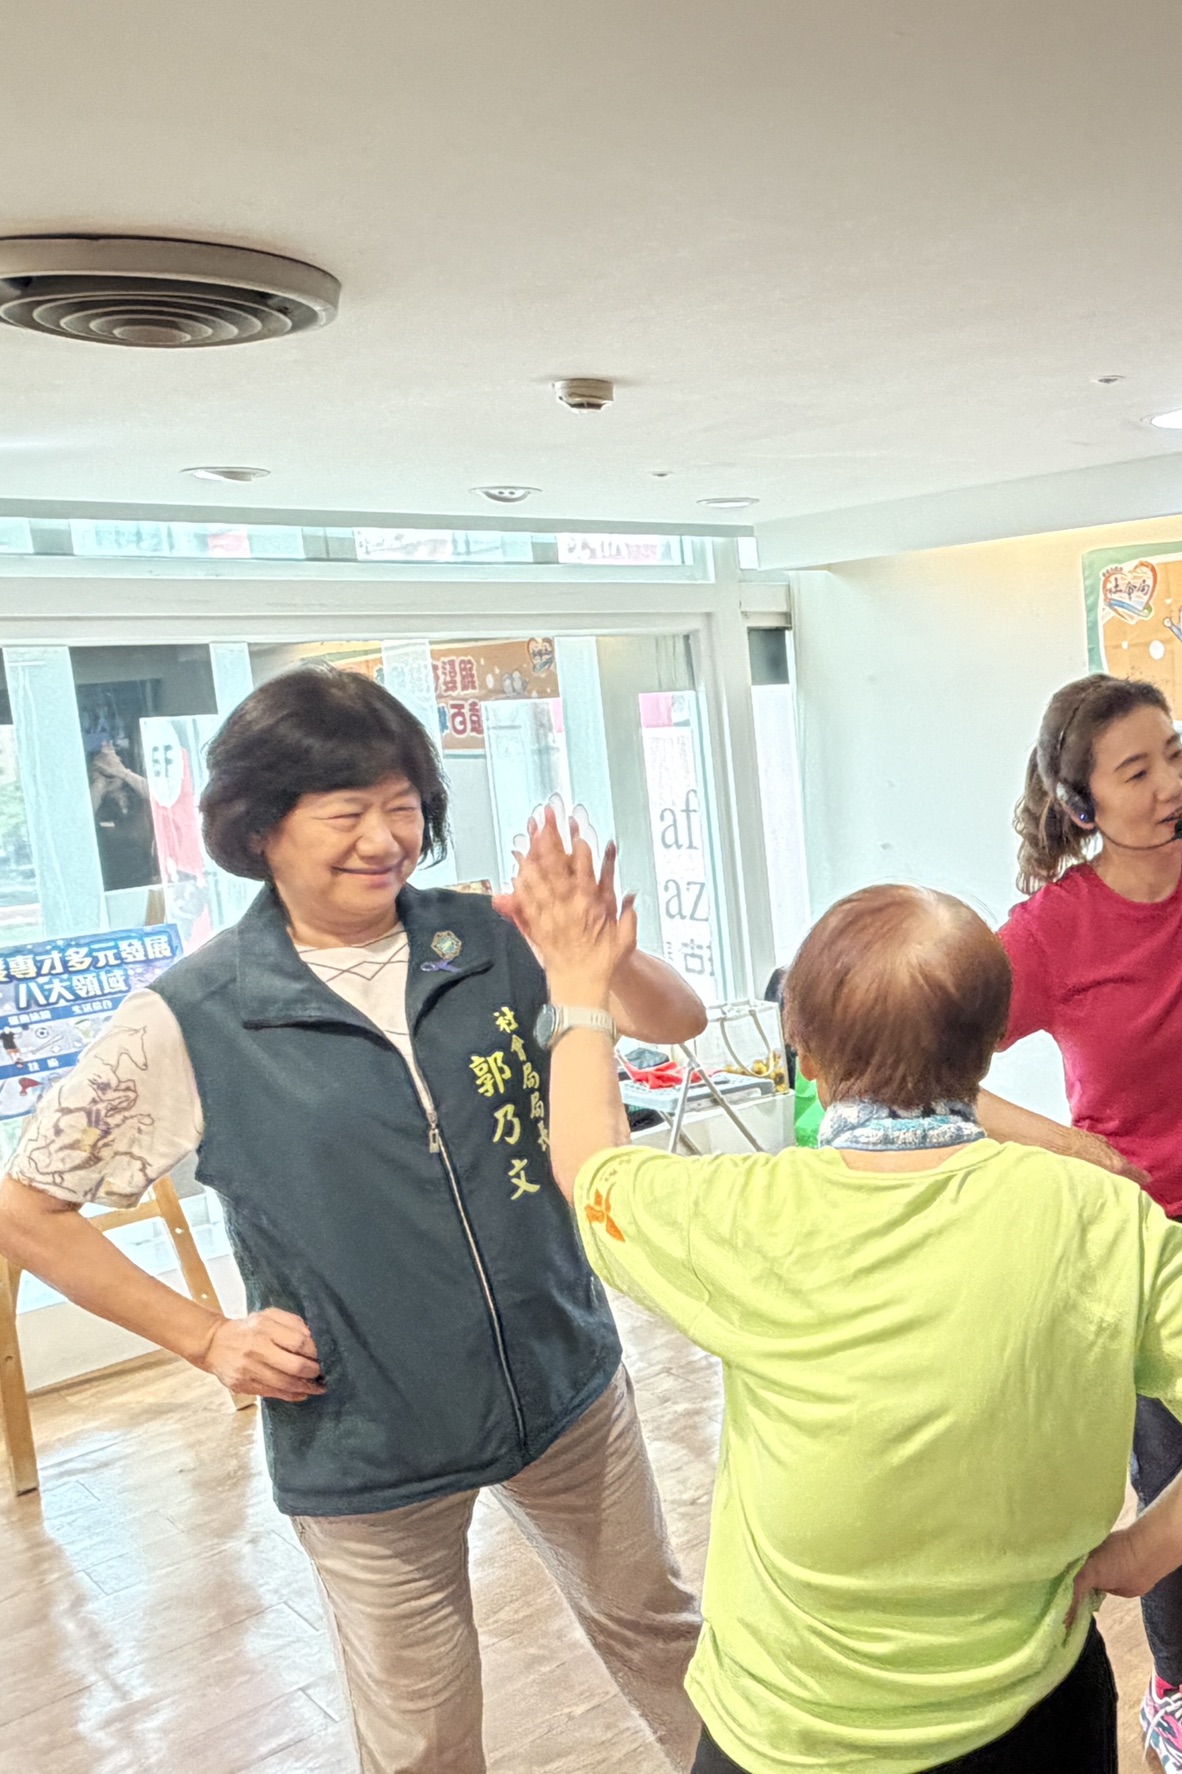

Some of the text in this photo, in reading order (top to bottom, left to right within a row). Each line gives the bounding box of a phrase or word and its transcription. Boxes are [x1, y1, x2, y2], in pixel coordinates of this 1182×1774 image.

[18, 972, 129, 1009] 八大領域
[469, 1051, 540, 1200] 郭乃文
